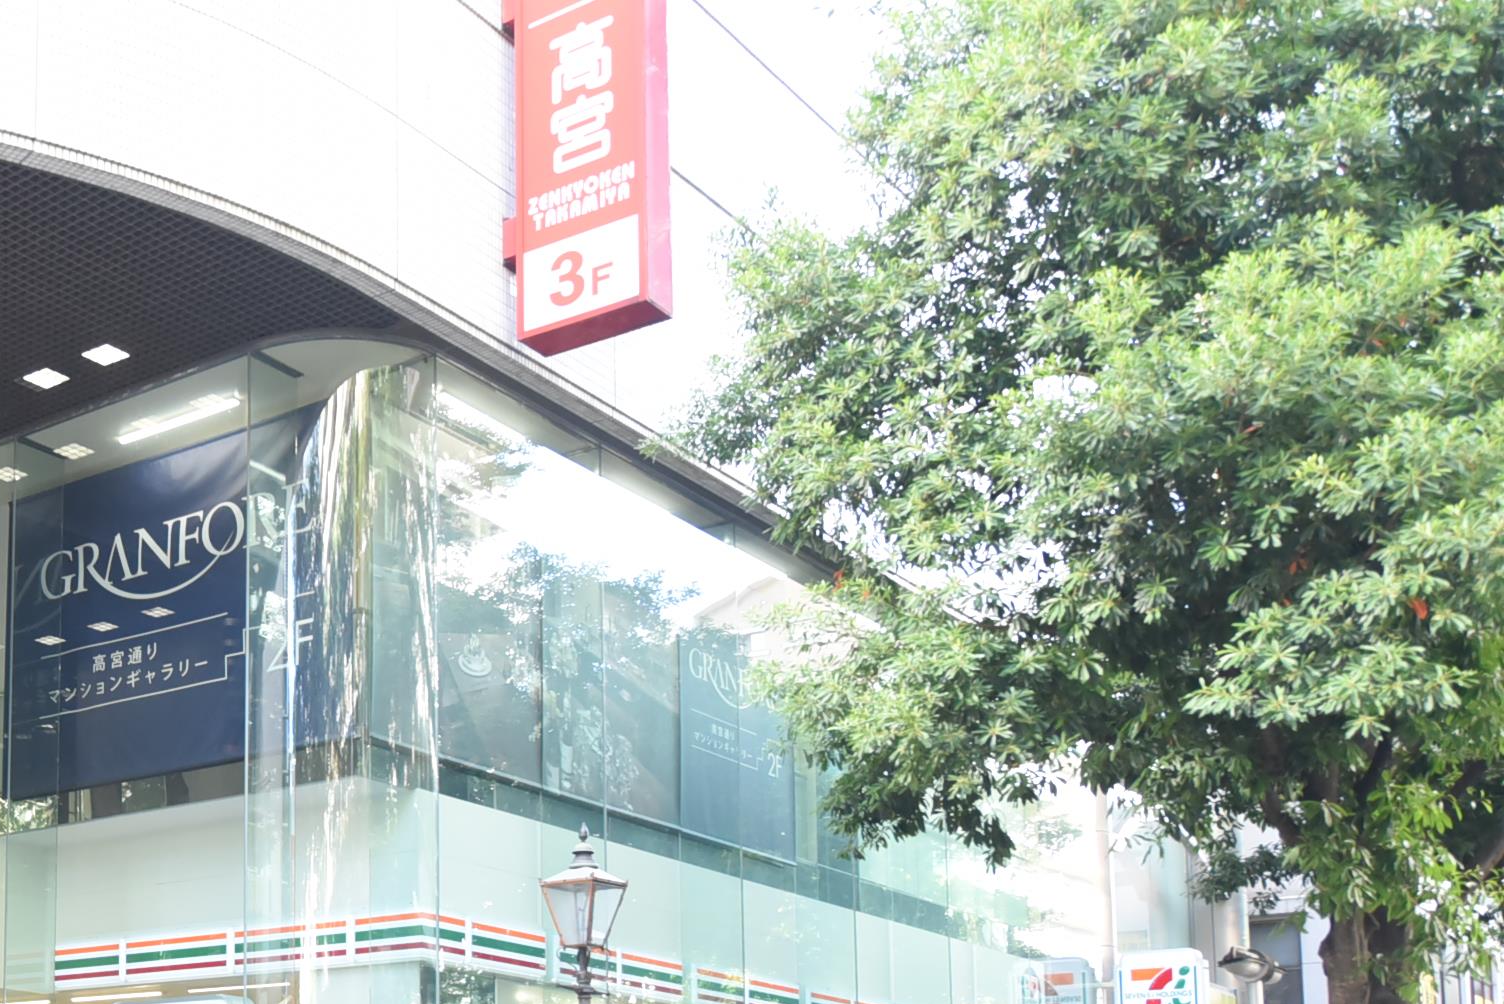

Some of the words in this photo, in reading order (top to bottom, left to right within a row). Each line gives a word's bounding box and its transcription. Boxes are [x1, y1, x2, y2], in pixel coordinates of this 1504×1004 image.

[548, 15, 615, 175] 高宮
[527, 160, 636, 216] ZENKYOKEN
[532, 181, 631, 231] TAKAMIYA
[549, 250, 614, 307] 3F
[48, 660, 208, 705] マンションギャラリー
[91, 642, 158, 674] 高宮通り
